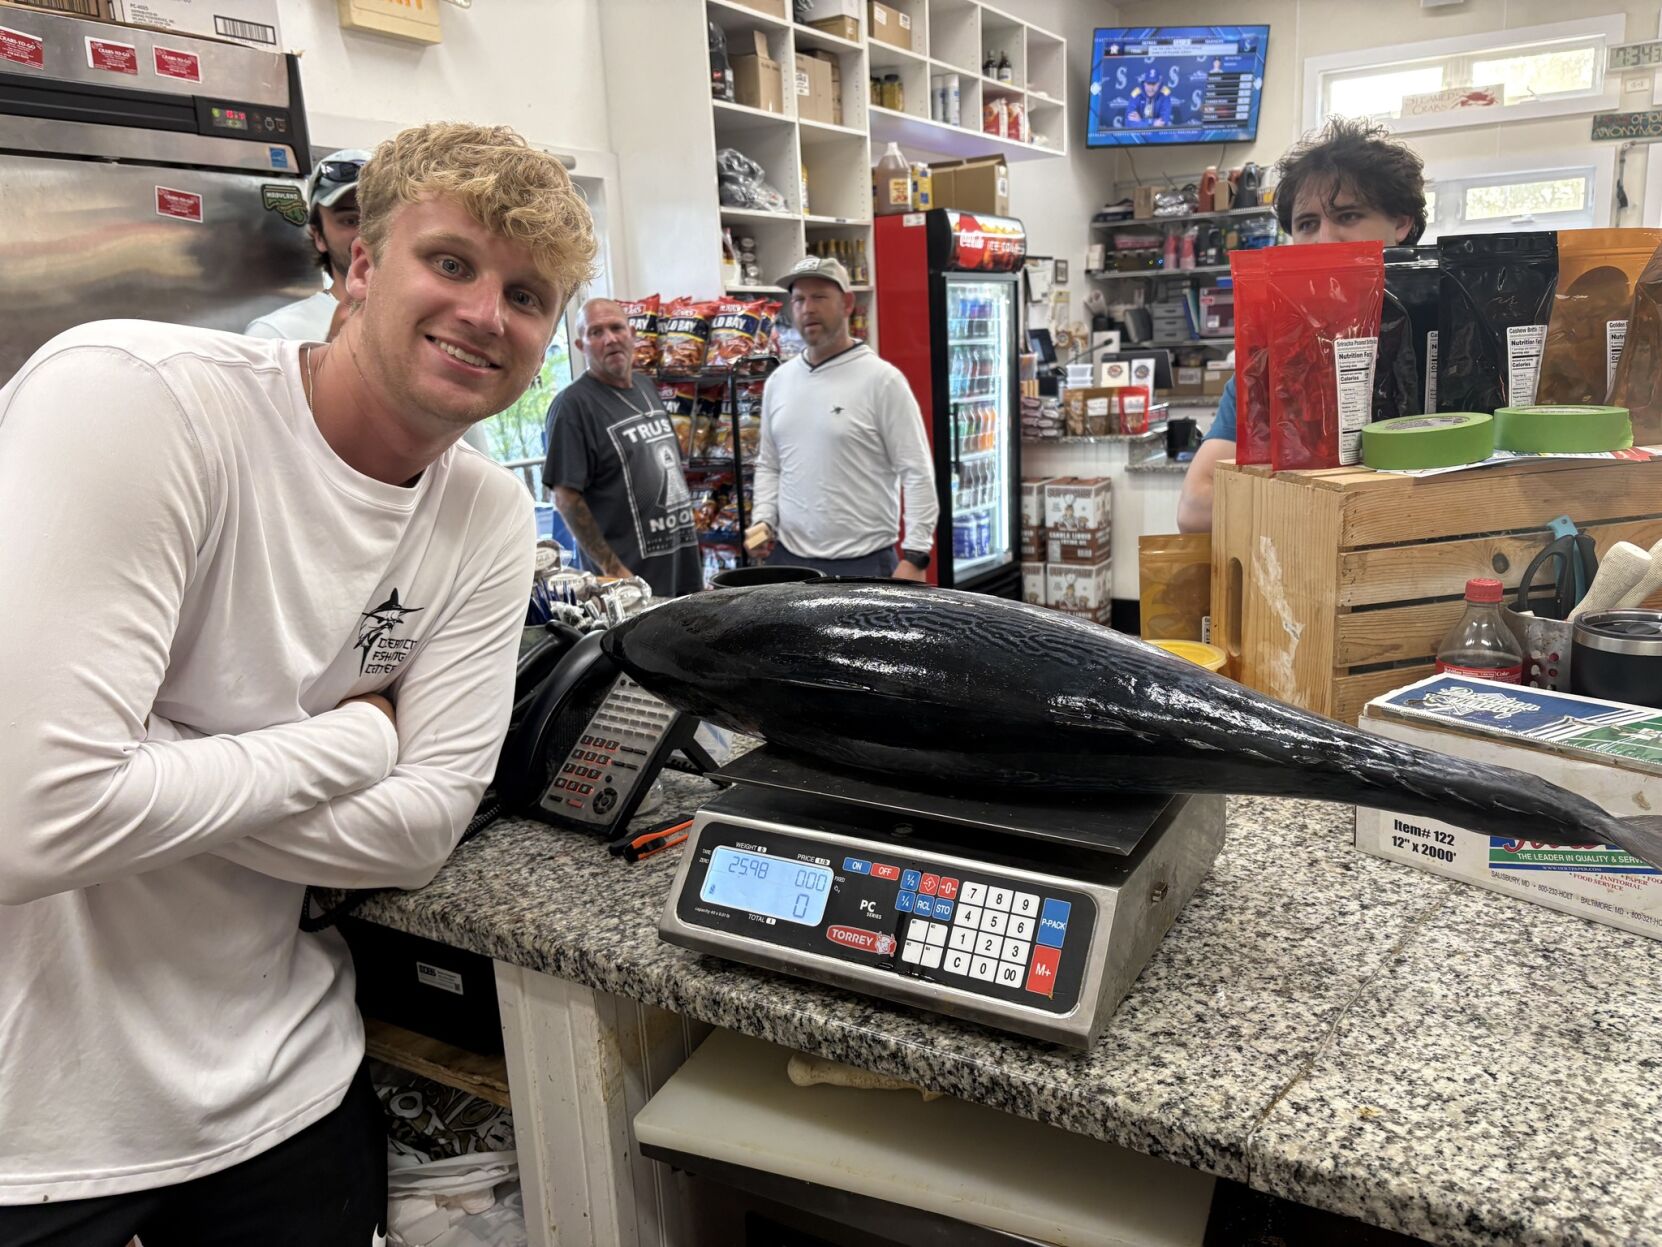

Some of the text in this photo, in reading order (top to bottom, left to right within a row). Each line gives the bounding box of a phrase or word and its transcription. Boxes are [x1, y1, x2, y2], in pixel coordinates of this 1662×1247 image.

[1338, 352, 1363, 360] Nutrition
[1394, 819, 1455, 847] Item# 122
[735, 841, 758, 851] WEIGHT
[1392, 835, 1457, 863] 12" x 2000'
[797, 853, 815, 863] PRICE
[1516, 853, 1533, 861] THE
[1533, 853, 1565, 862] LEADER
[1565, 854, 1574, 862] IN
[1575, 855, 1609, 864] QUALITY
[1611, 856, 1617, 864] &
[852, 861, 862, 871] ON
[878, 866, 892, 876] OFF
[1573, 872, 1624, 892] FOOD SERVICE
[1600, 874, 1642, 891] JANITORIAL
[1626, 874, 1648, 887] PAPER
[969, 888, 978, 899] 7
[1491, 870, 1520, 885] SALISBURY,
[1521, 879, 1530, 888] MD
[1614, 906, 1624, 915] MD
[995, 893, 1003, 905] 8
[1022, 899, 1030, 911] 9
[860, 899, 877, 913] PC
[916, 900, 931, 912] RCL
[936, 904, 951, 915] STO
[748, 913, 765, 923] TOTAL
[866, 912, 882, 920] SERIES
[964, 910, 972, 922] 4
[990, 916, 998, 928] 5
[1017, 922, 1025, 934] 6
[1041, 917, 1067, 930] P-PACK
[832, 928, 875, 946] TORREY
[960, 933, 966, 945] 1
[984, 939, 993, 951] 2
[1011, 945, 1019, 958] 3
[953, 957, 961, 969] C
[979, 963, 987, 975] 0
[1003, 968, 1017, 982] 00
[1035, 962, 1052, 977] M+
